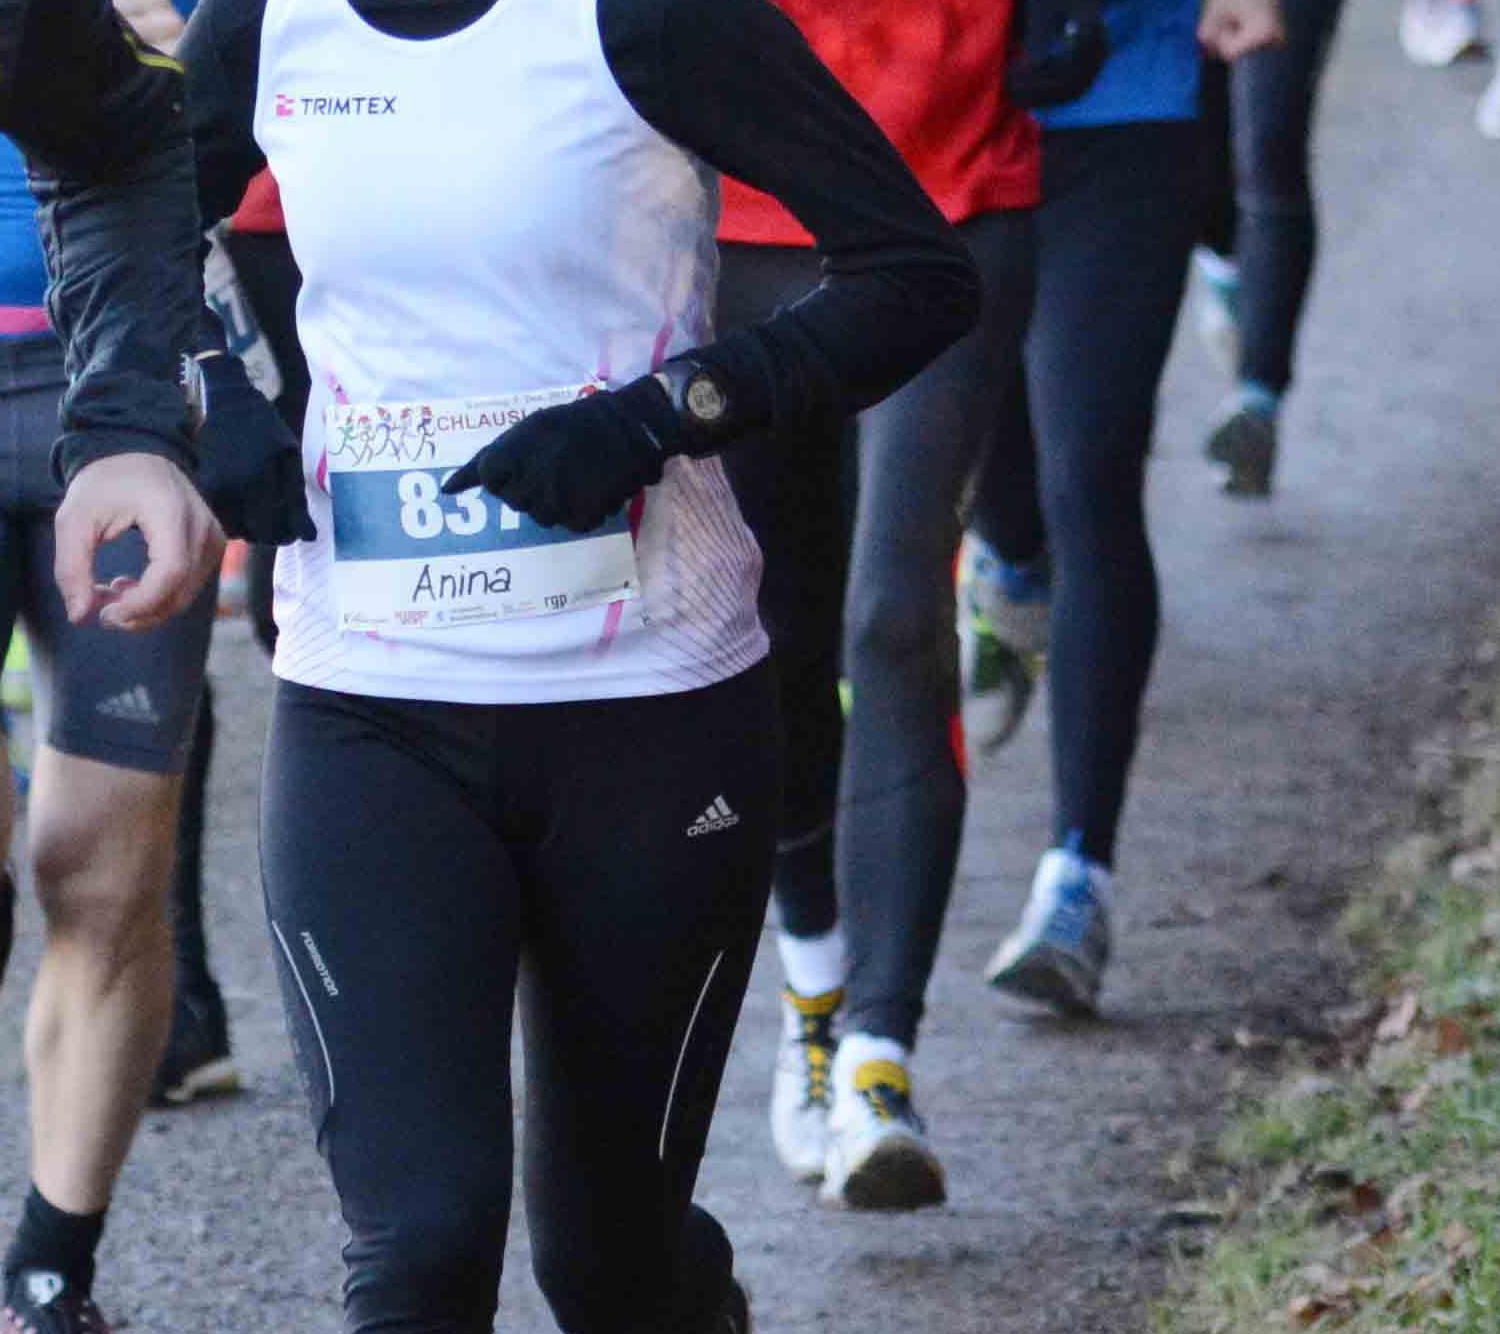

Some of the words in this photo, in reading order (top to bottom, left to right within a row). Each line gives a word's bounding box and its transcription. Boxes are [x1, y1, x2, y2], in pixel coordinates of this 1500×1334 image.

[300, 95, 398, 116] TRIMTEX
[411, 563, 512, 603] Anina
[544, 594, 568, 610] rgp
[686, 814, 740, 838] adidas
